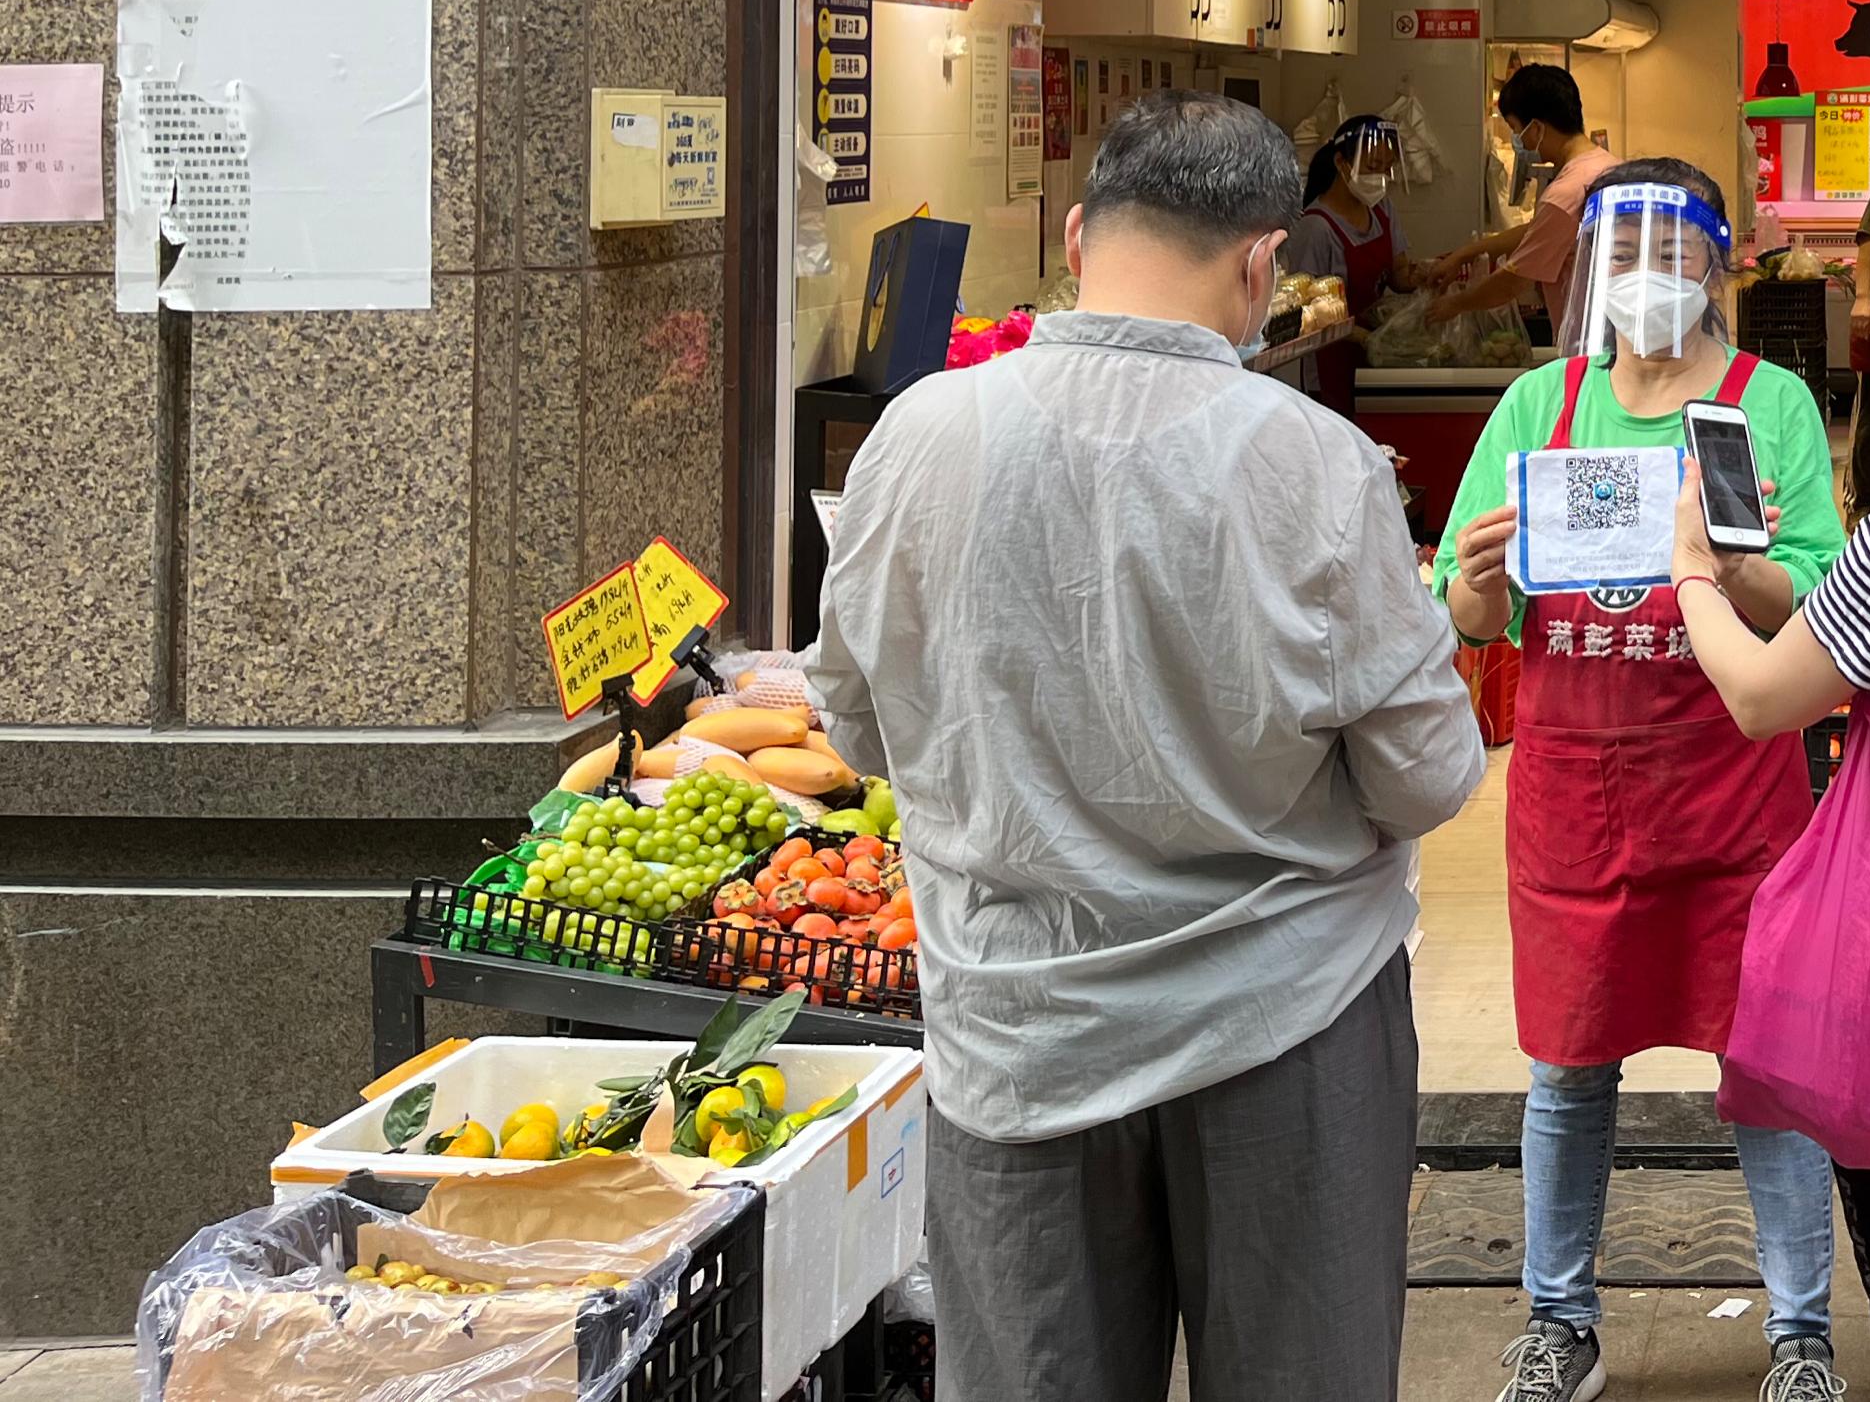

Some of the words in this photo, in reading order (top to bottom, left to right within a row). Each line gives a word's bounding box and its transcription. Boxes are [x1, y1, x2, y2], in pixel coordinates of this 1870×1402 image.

[835, 18, 860, 35] 戴好口罩
[834, 58, 860, 75] 扫码亮码
[834, 99, 859, 114] 测量体温
[1819, 110, 1839, 121] 今日
[1546, 619, 1696, 661] 满彭菜场
